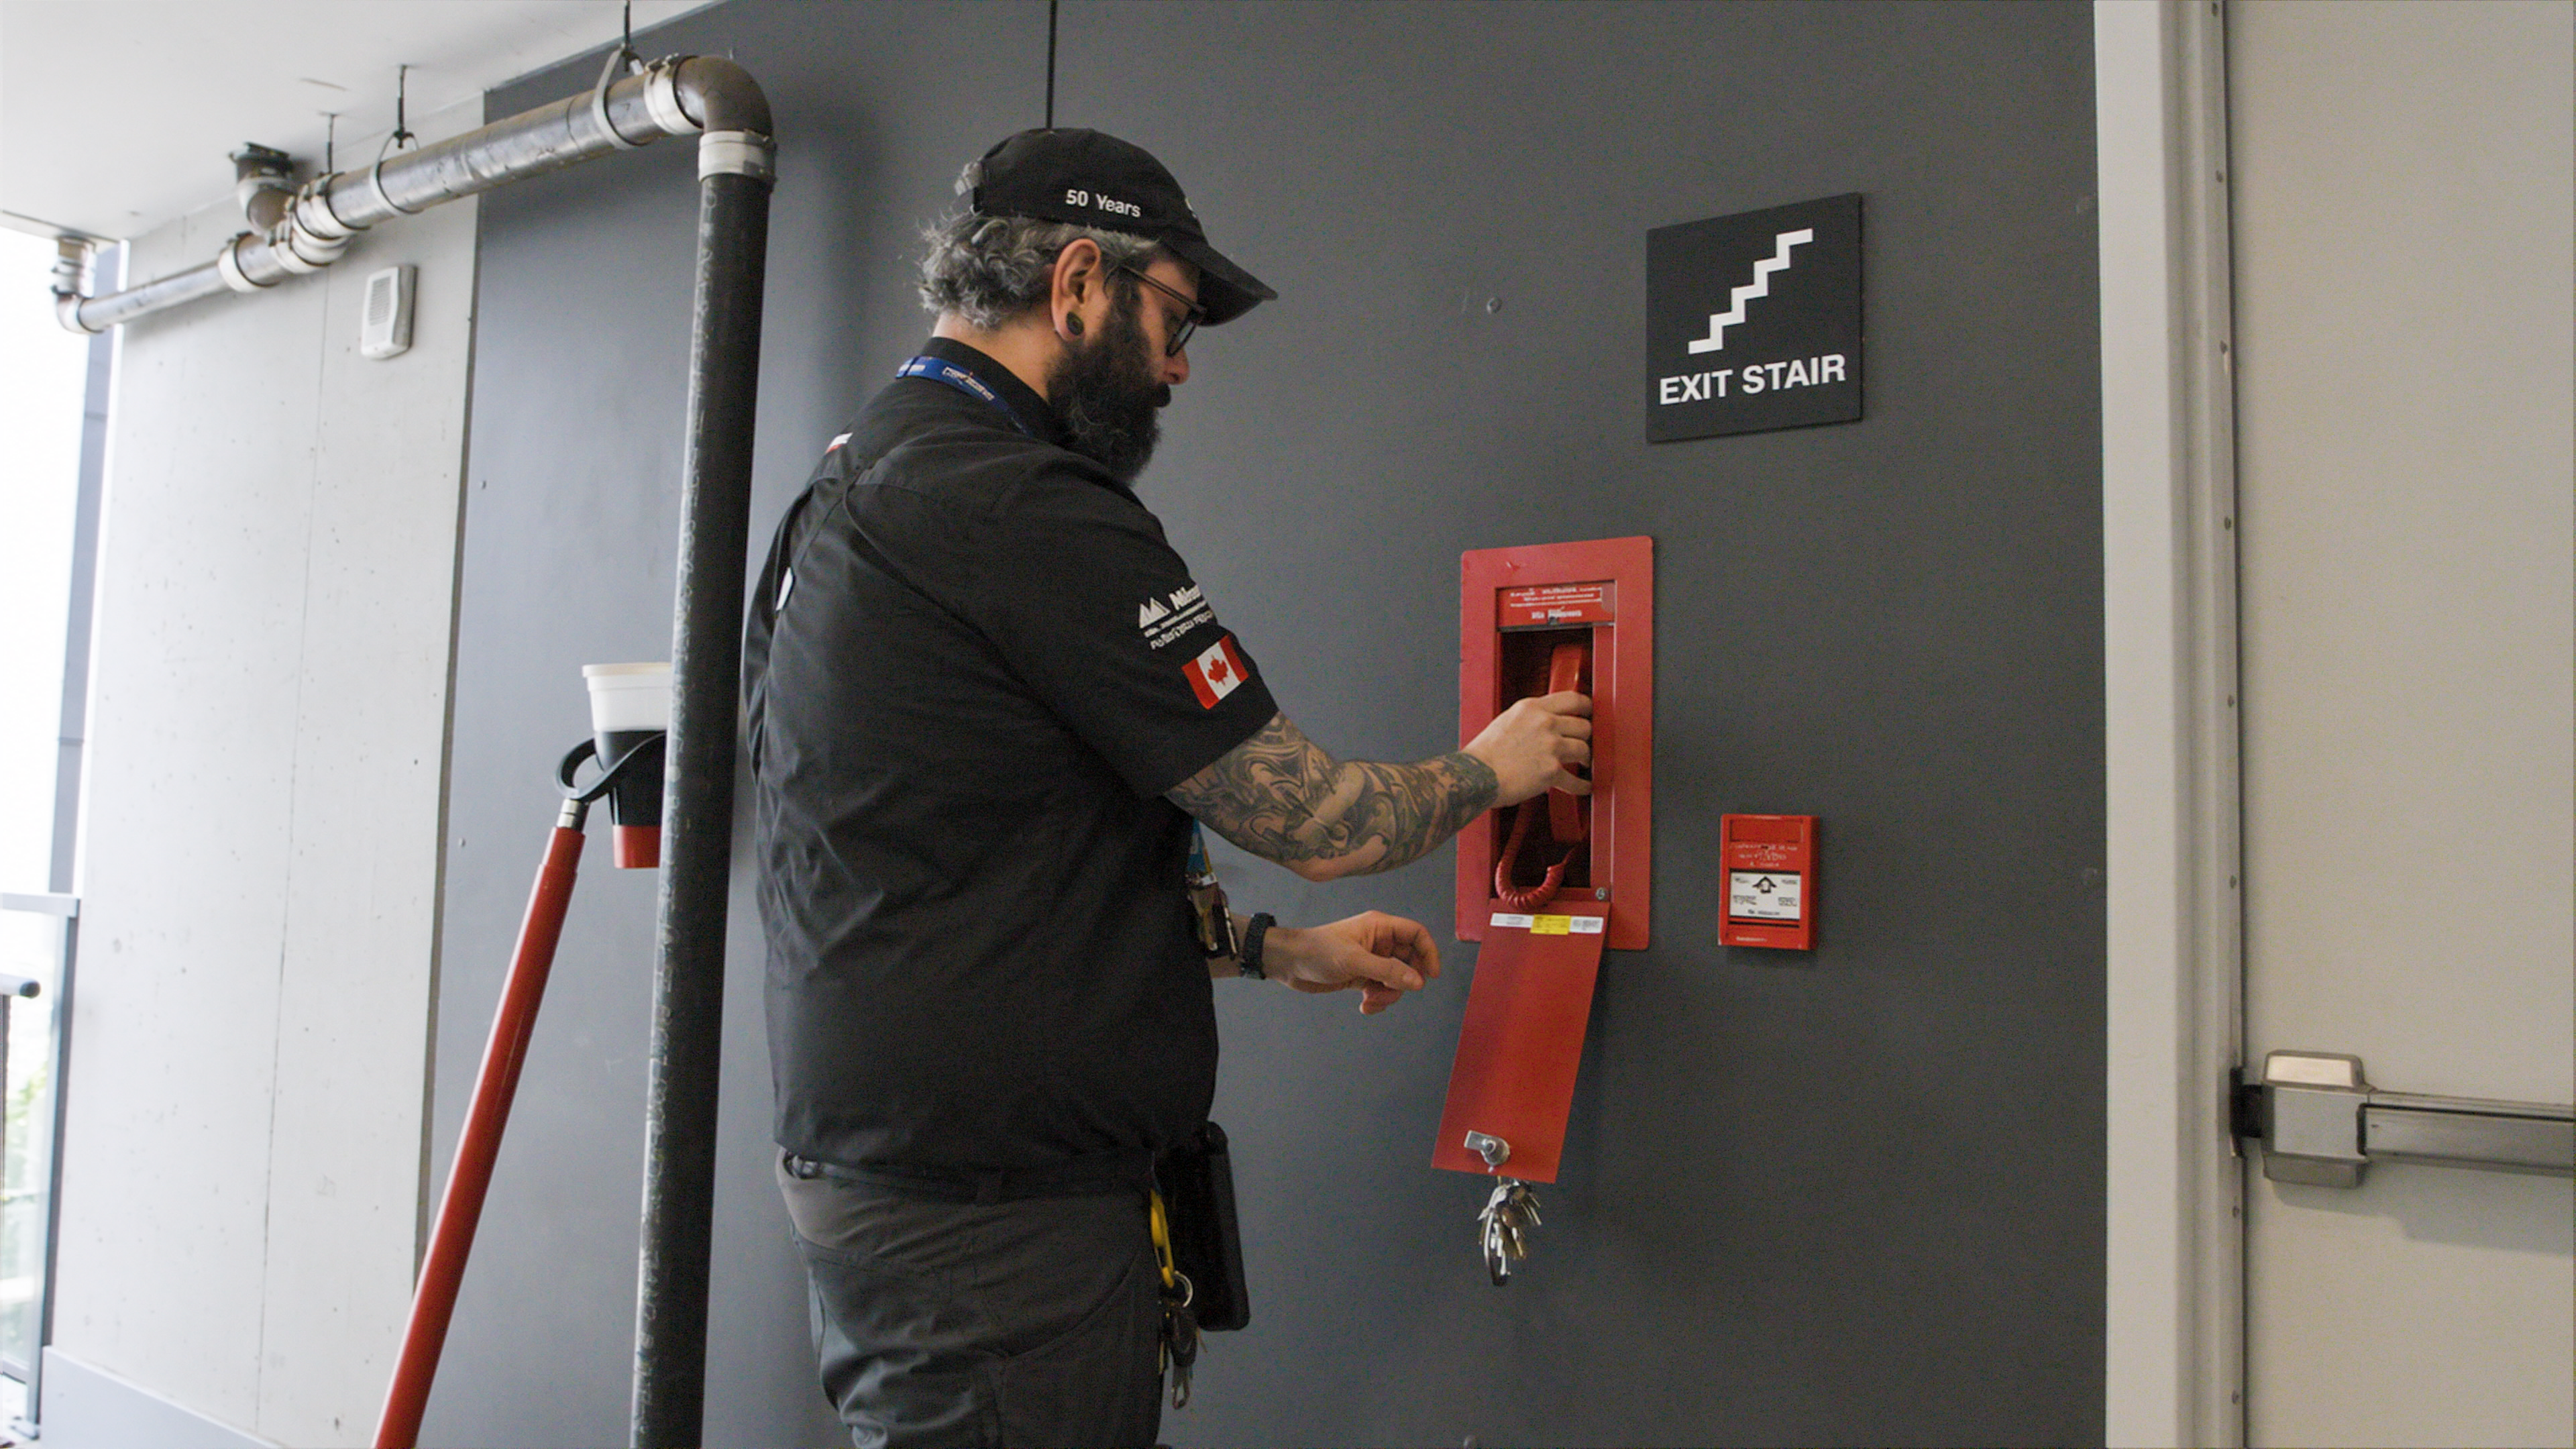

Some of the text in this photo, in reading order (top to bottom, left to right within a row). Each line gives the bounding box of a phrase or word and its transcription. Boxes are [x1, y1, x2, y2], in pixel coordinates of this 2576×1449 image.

[1065, 189, 1142, 218] 50 Years
[1660, 353, 1846, 405] EXIT STAIR
